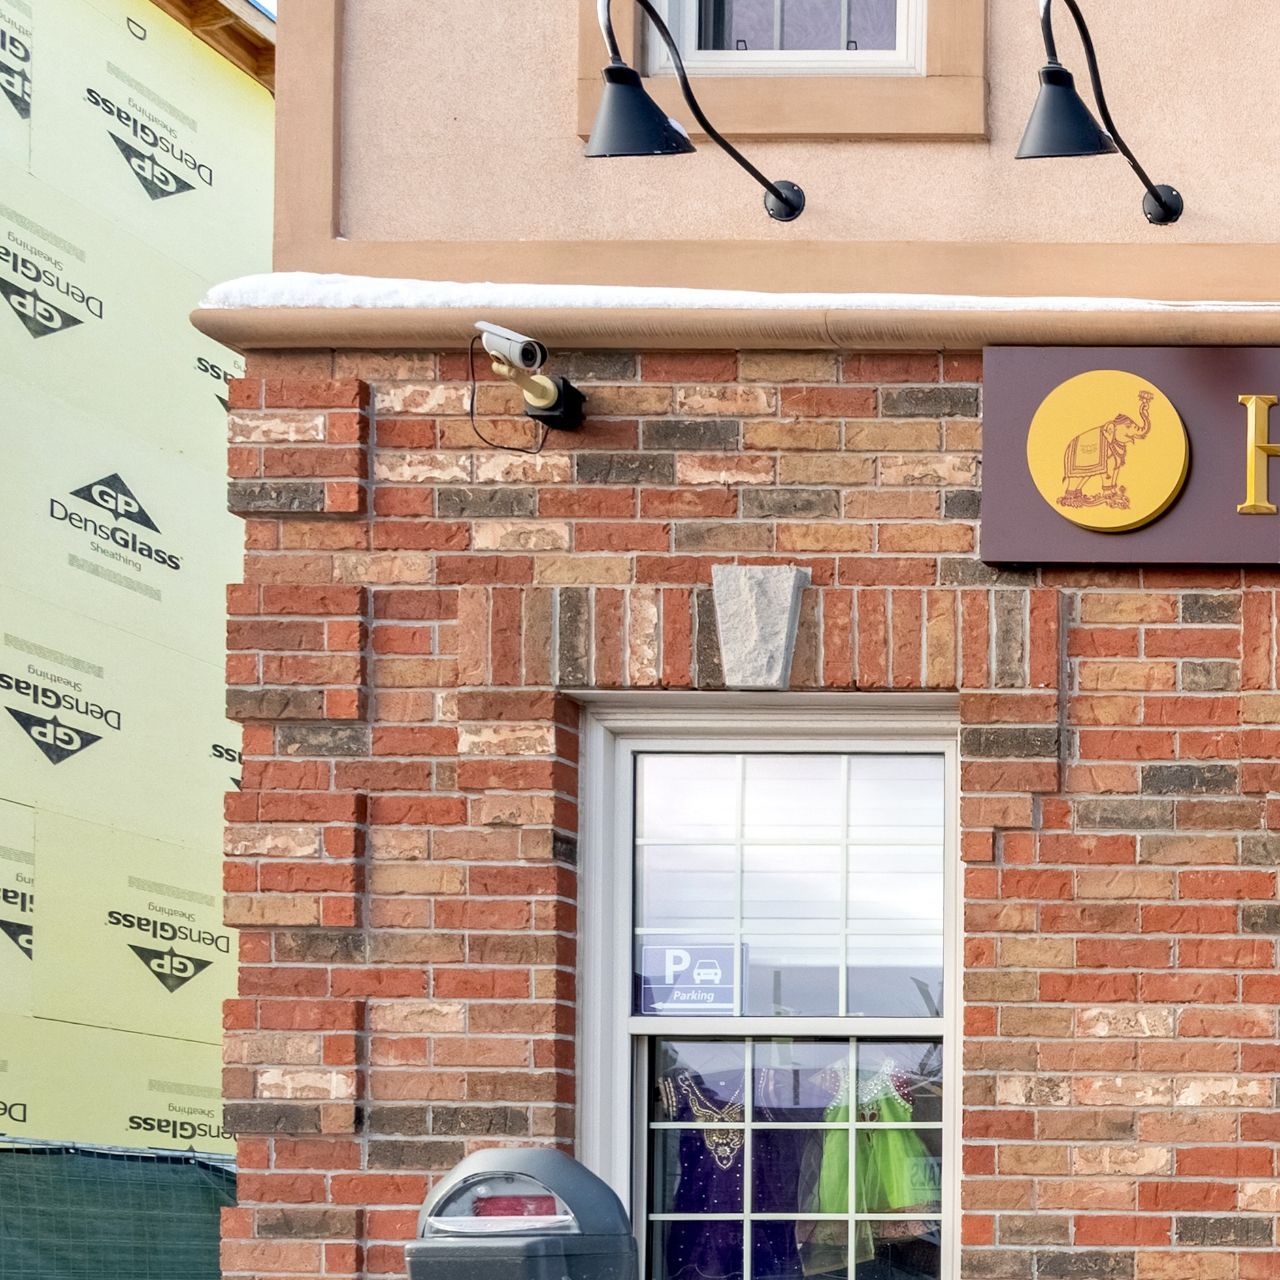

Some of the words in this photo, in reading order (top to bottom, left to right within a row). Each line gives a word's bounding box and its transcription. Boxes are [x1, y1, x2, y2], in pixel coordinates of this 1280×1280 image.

[127, 96, 177, 139] Sheathing
[86, 88, 213, 186] DensGlass
[130, 157, 177, 193] GP
[7, 231, 64, 272] Sheathing
[9, 293, 62, 329] GP
[91, 484, 140, 514] GP
[50, 498, 180, 571] DensGlass
[90, 541, 141, 572] Sheathing
[27, 664, 82, 692] Sheathing
[30, 722, 82, 751] GP
[148, 902, 196, 923] Sheathing
[107, 910, 230, 954] DensGlass
[150, 954, 195, 978] GP
[673, 989, 715, 1004] Parking
[168, 1102, 215, 1119] Sheathing
